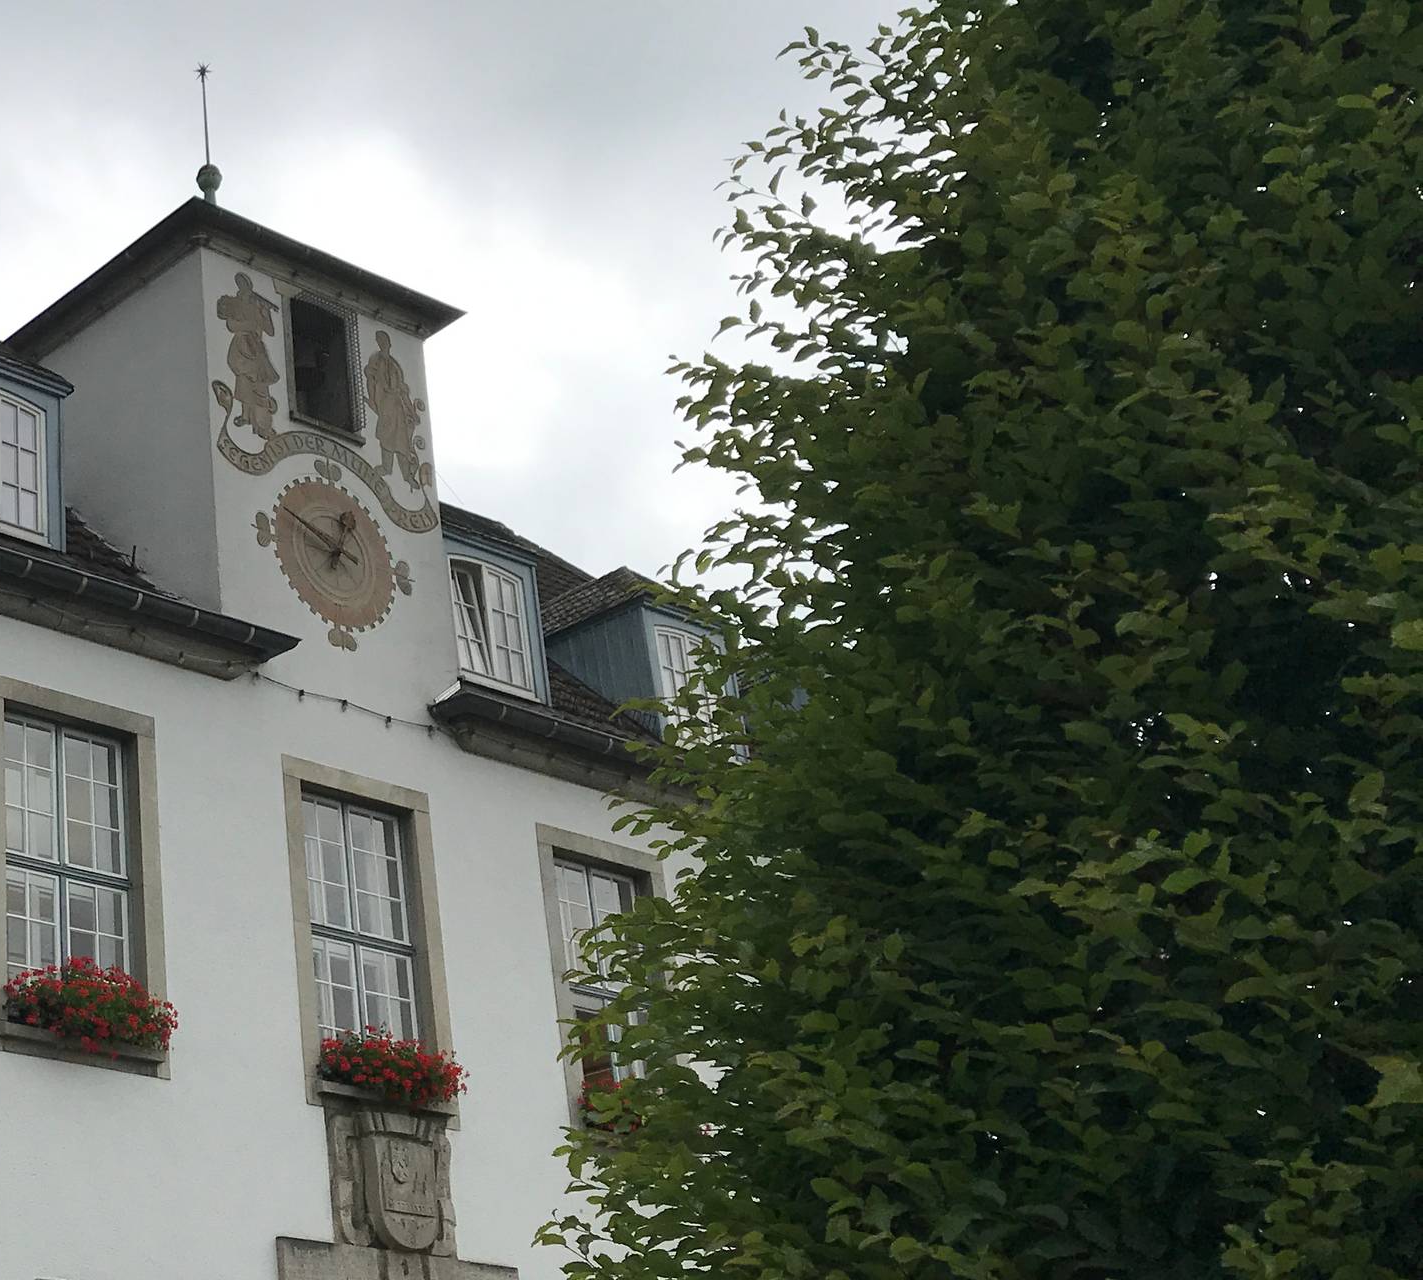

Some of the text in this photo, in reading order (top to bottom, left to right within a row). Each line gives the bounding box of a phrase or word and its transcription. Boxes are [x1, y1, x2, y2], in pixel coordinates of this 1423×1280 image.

[219, 438, 274, 471] SEGEN
[268, 436, 290, 458] IST
[292, 434, 328, 454] DER
